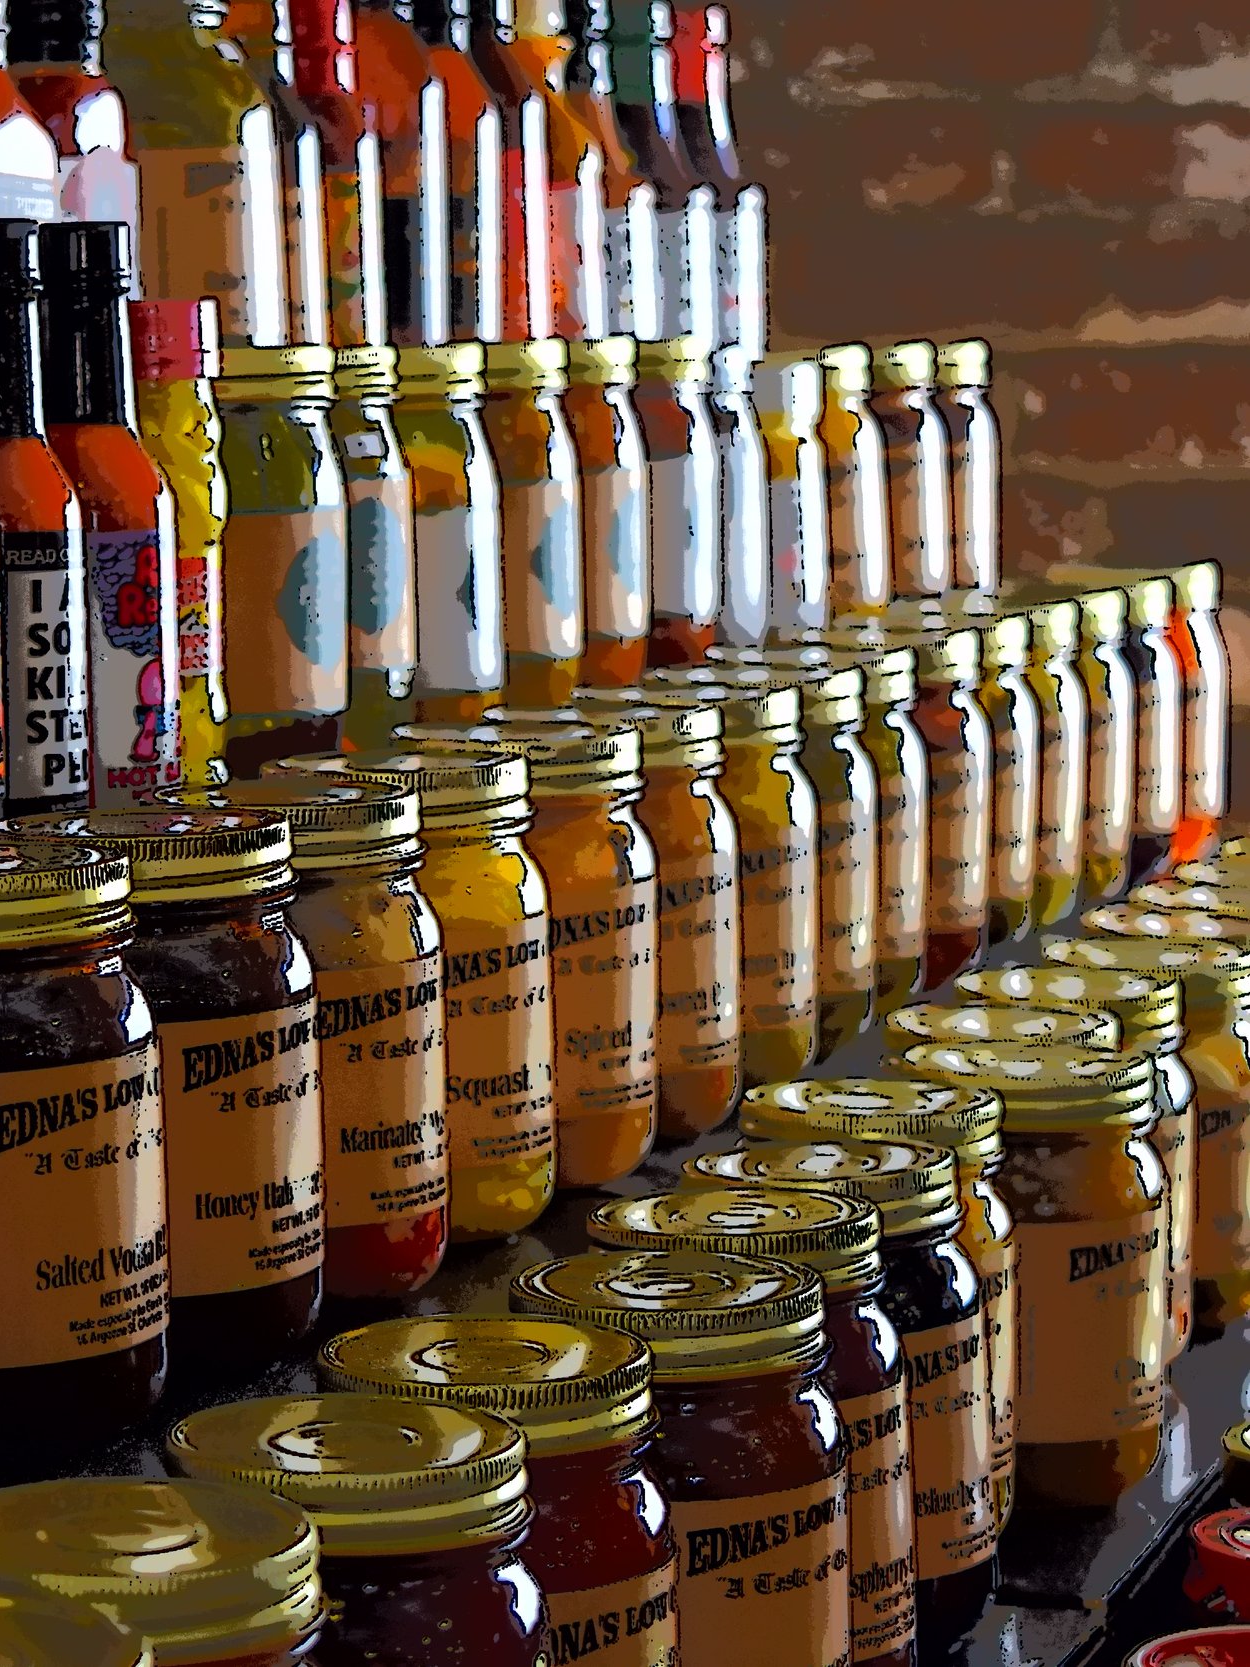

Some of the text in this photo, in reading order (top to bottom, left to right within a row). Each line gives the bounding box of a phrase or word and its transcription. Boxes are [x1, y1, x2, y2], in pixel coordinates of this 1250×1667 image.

[6, 550, 54, 565] READ
[312, 987, 402, 1040] EDNA'S
[182, 1030, 275, 1094] EDNA'S
[195, 1190, 260, 1221] Honey
[36, 1247, 106, 1292] Salted
[100, 1288, 122, 1309] NET
[685, 1514, 791, 1578] EDNA'S
